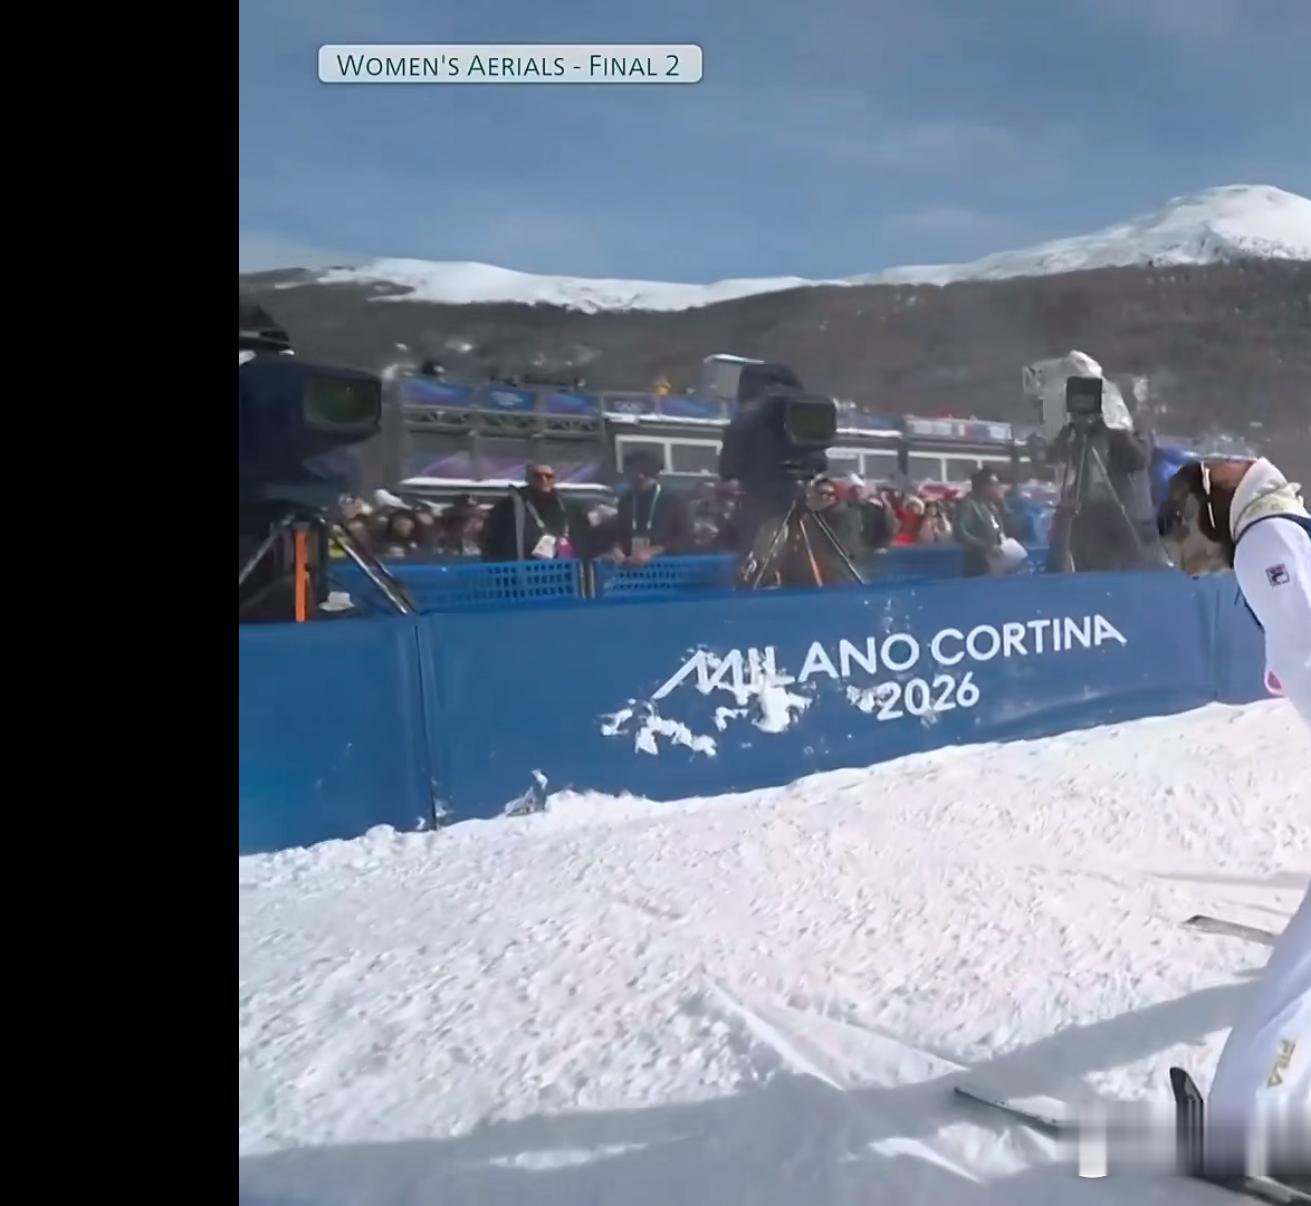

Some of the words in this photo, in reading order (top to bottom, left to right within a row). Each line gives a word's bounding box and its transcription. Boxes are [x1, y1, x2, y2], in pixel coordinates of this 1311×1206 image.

[651, 632, 919, 700] MILANO
[931, 613, 1127, 665] CORTINA
[877, 671, 980, 721] 2026
[1267, 1038, 1297, 1088] FILA
